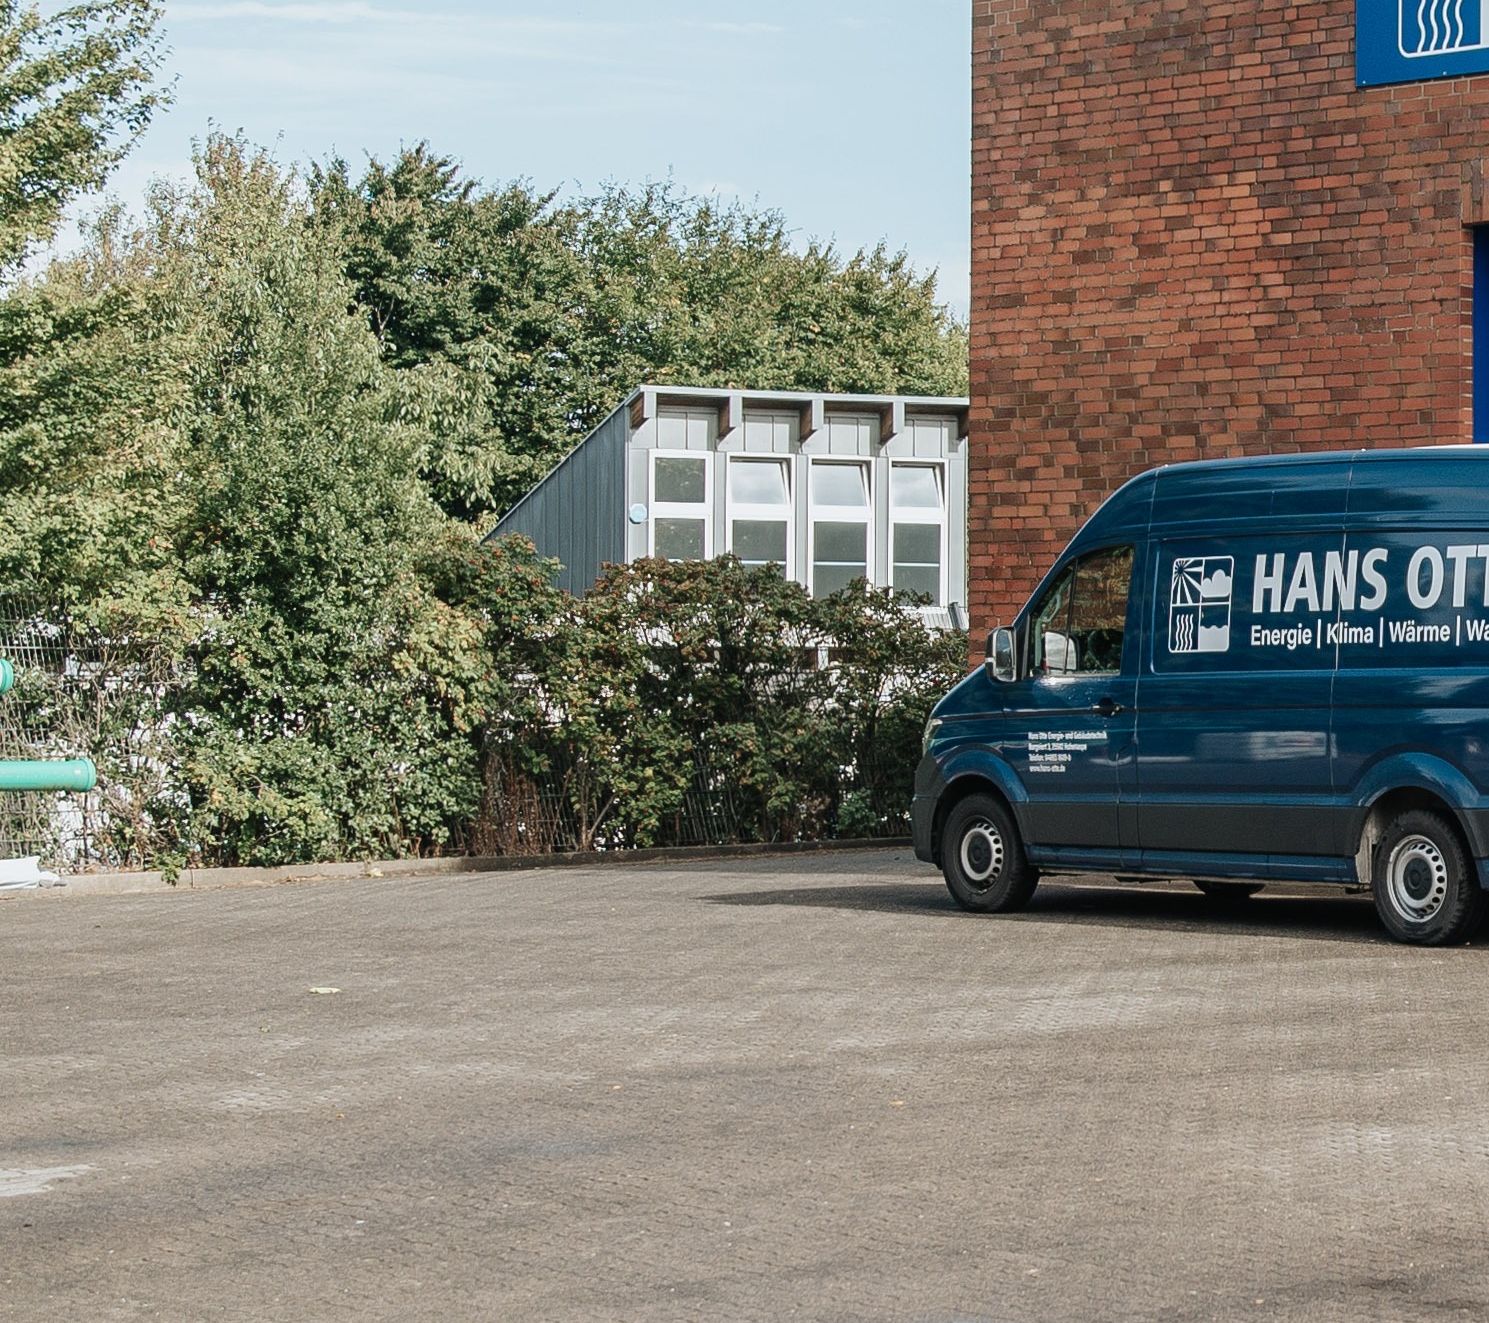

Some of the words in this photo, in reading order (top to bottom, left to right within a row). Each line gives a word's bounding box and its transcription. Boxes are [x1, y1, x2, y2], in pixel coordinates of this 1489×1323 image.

[1253, 548, 1389, 613] HANS
[1251, 623, 1312, 650] Energie
[1326, 622, 1374, 644] Klima
[1389, 620, 1450, 642] Wärme
